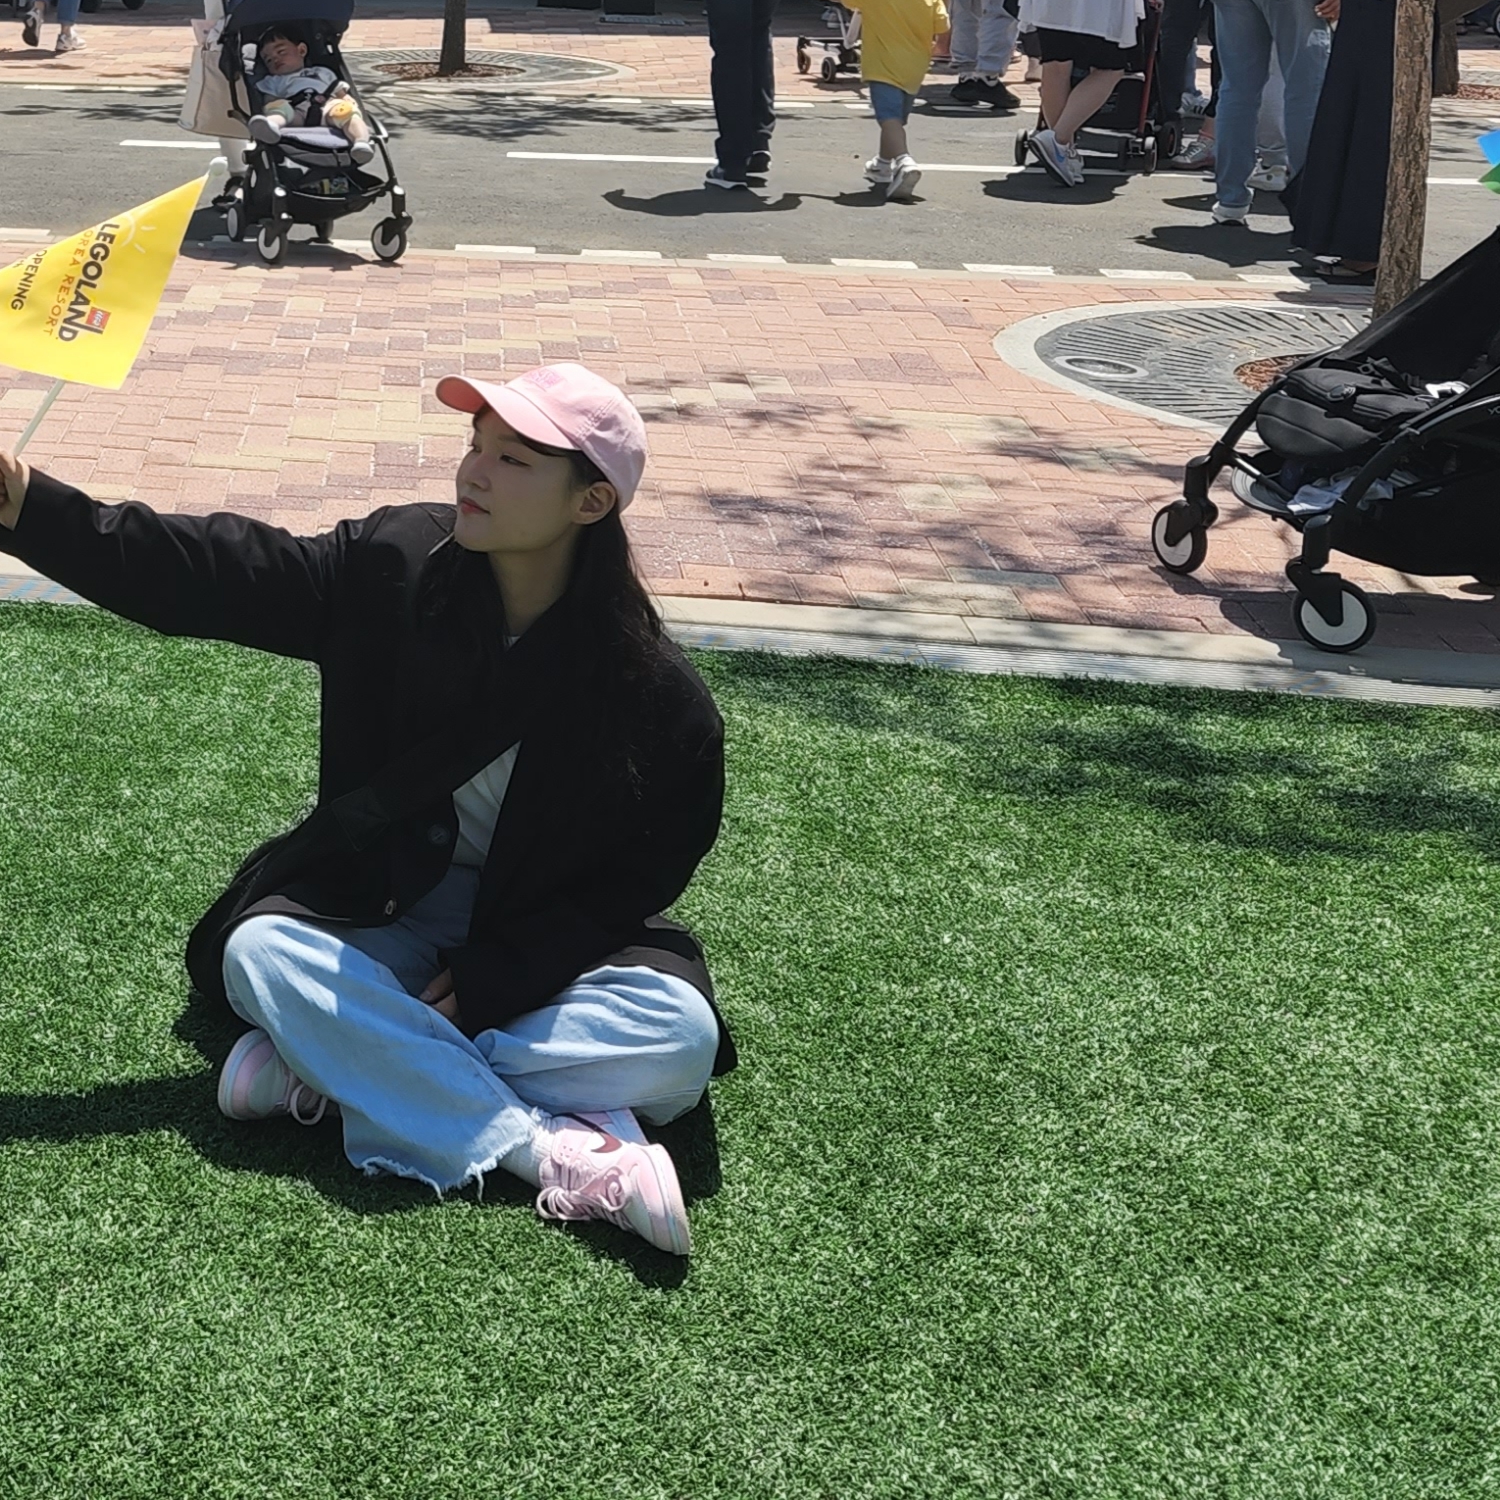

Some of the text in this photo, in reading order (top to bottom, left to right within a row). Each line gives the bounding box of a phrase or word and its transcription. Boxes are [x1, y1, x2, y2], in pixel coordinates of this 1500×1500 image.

[10, 250, 47, 311] OPENING
[43, 274, 76, 336] RESORT
[58, 223, 120, 342] LEGOLAND
